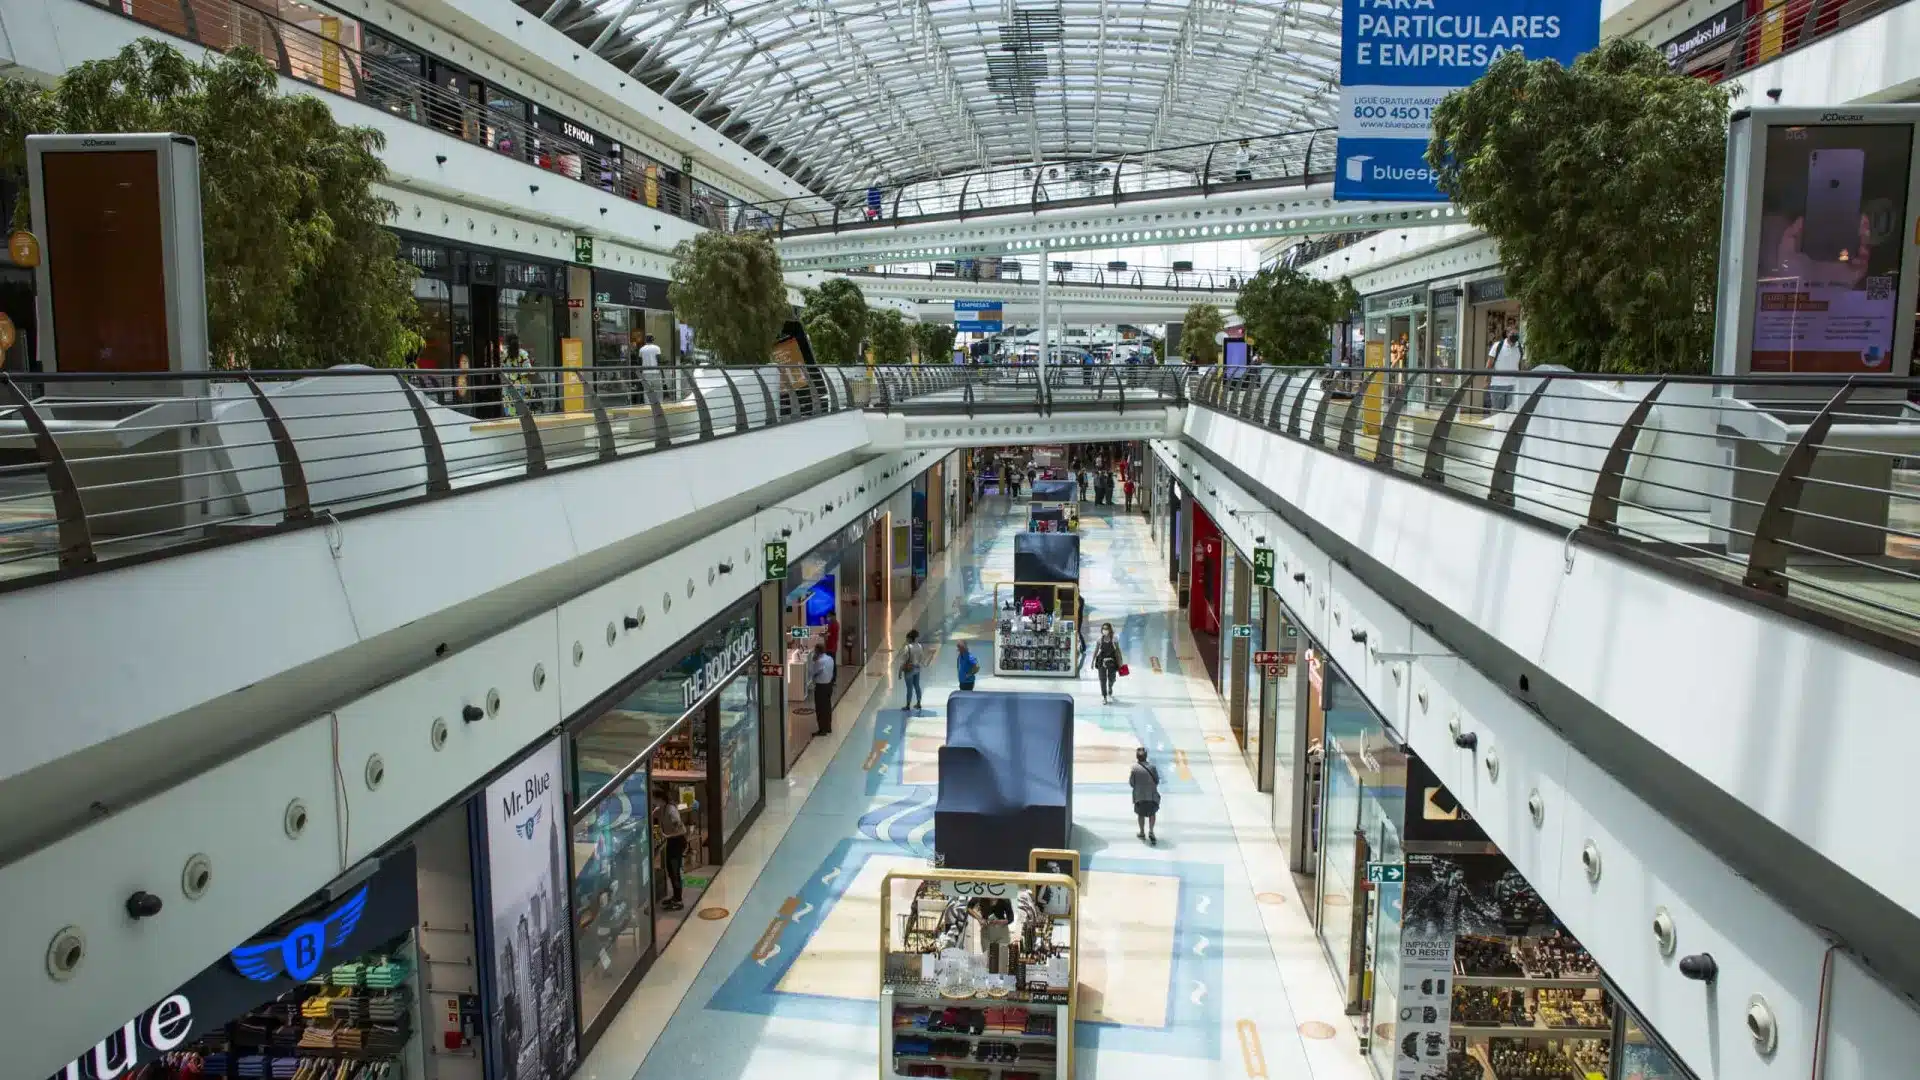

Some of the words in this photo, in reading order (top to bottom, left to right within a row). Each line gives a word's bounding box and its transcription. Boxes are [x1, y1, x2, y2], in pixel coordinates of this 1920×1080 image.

[1358, 14, 1561, 38] PARTICULARES
[1357, 43, 1372, 65] E
[1354, 97, 1378, 105] LIGUE
[1380, 97, 1442, 105] GRATUITAMENT
[1354, 106, 1386, 118] 800
[1390, 107, 1420, 119] 450
[1820, 113, 1864, 121] JCDecaux
[563, 122, 594, 146] SEPHORA
[1373, 165, 1440, 184] bluesp
[681, 668, 704, 709] THE
[704, 644, 732, 690] BODY
[503, 791, 523, 823] Mr.
[525, 772, 550, 806] Blue
[295, 934, 316, 969] B
[1405, 941, 1451, 949] IMPROVED
[1418, 949, 1450, 957] RESIST
